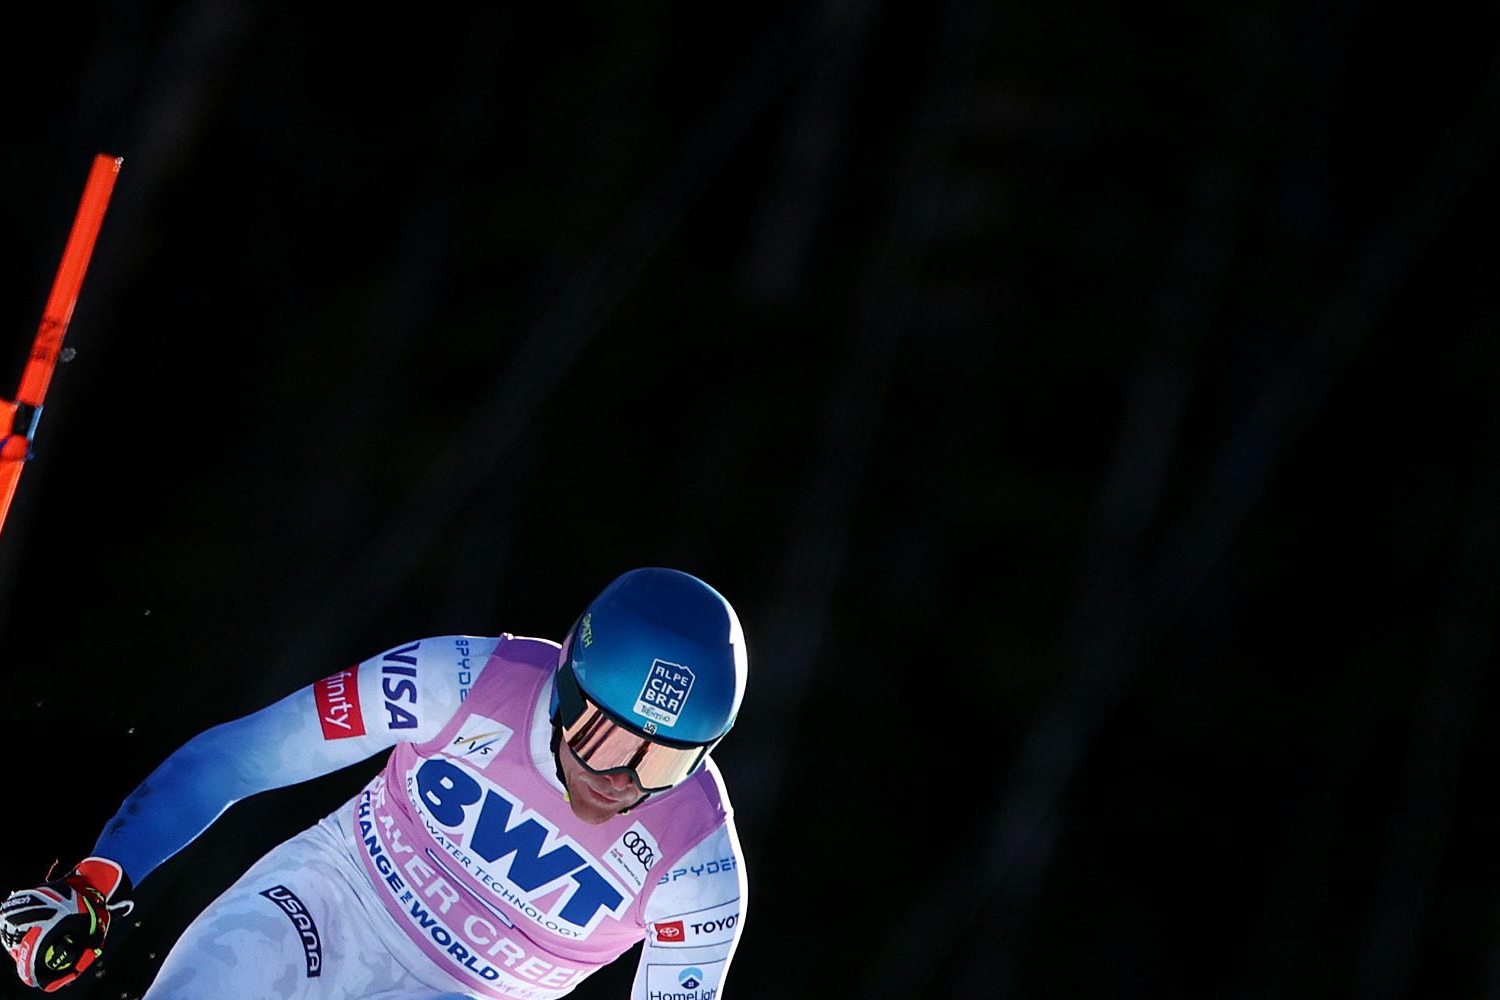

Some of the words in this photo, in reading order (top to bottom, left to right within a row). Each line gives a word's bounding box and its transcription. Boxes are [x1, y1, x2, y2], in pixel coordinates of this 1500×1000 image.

[382, 642, 420, 729] VISA
[645, 688, 679, 712] BRA
[651, 679, 684, 700] CIM
[655, 666, 688, 687] ALPE
[416, 759, 624, 928] BWT
[426, 820, 471, 868] WATER
[476, 866, 582, 938] TECHNOLOGY
[52, 951, 67, 968] LEKI
[269, 888, 319, 972] USANA
[410, 901, 499, 981] WORLD
